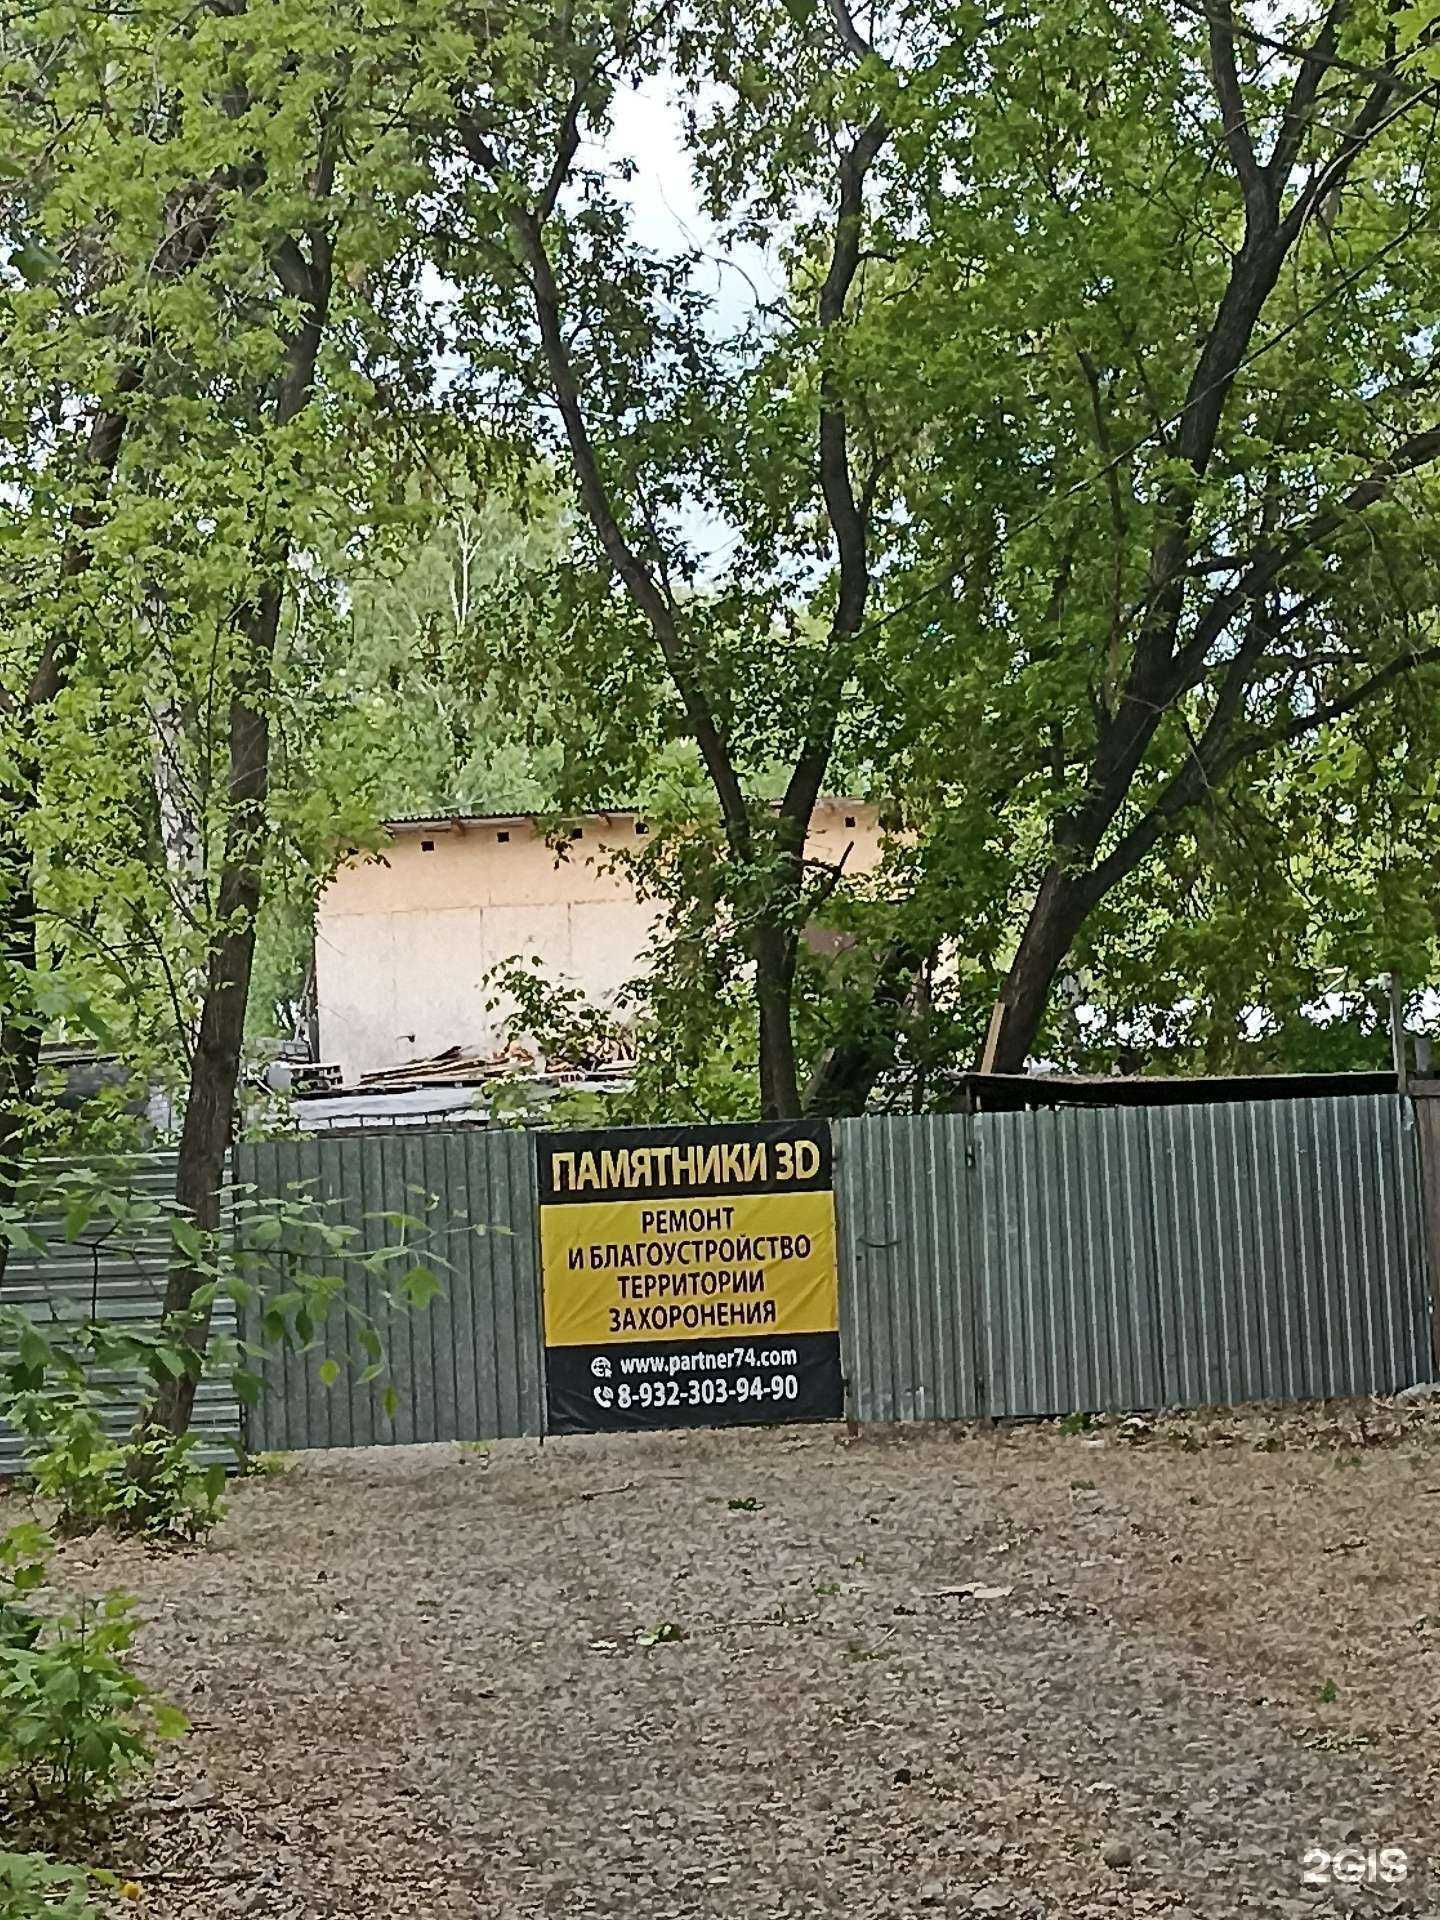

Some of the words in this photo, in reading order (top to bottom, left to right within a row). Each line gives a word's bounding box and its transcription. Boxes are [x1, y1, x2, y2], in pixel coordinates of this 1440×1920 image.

[552, 1143, 767, 1191] ПАМЯТНИКИ
[775, 1140, 820, 1181] 3D
[642, 1207, 735, 1234] РЕМОНТ
[568, 1247, 584, 1270] И
[590, 1233, 811, 1269] БЛАГОУСТРОЙСТВО
[617, 1270, 764, 1299] ТЕРРИТОРИИ
[609, 1300, 776, 1332] ЗАХОРОНЕНИЯ
[620, 1348, 797, 1375] www.partner74.com
[618, 1375, 798, 1408] 8-932-303-94-90
